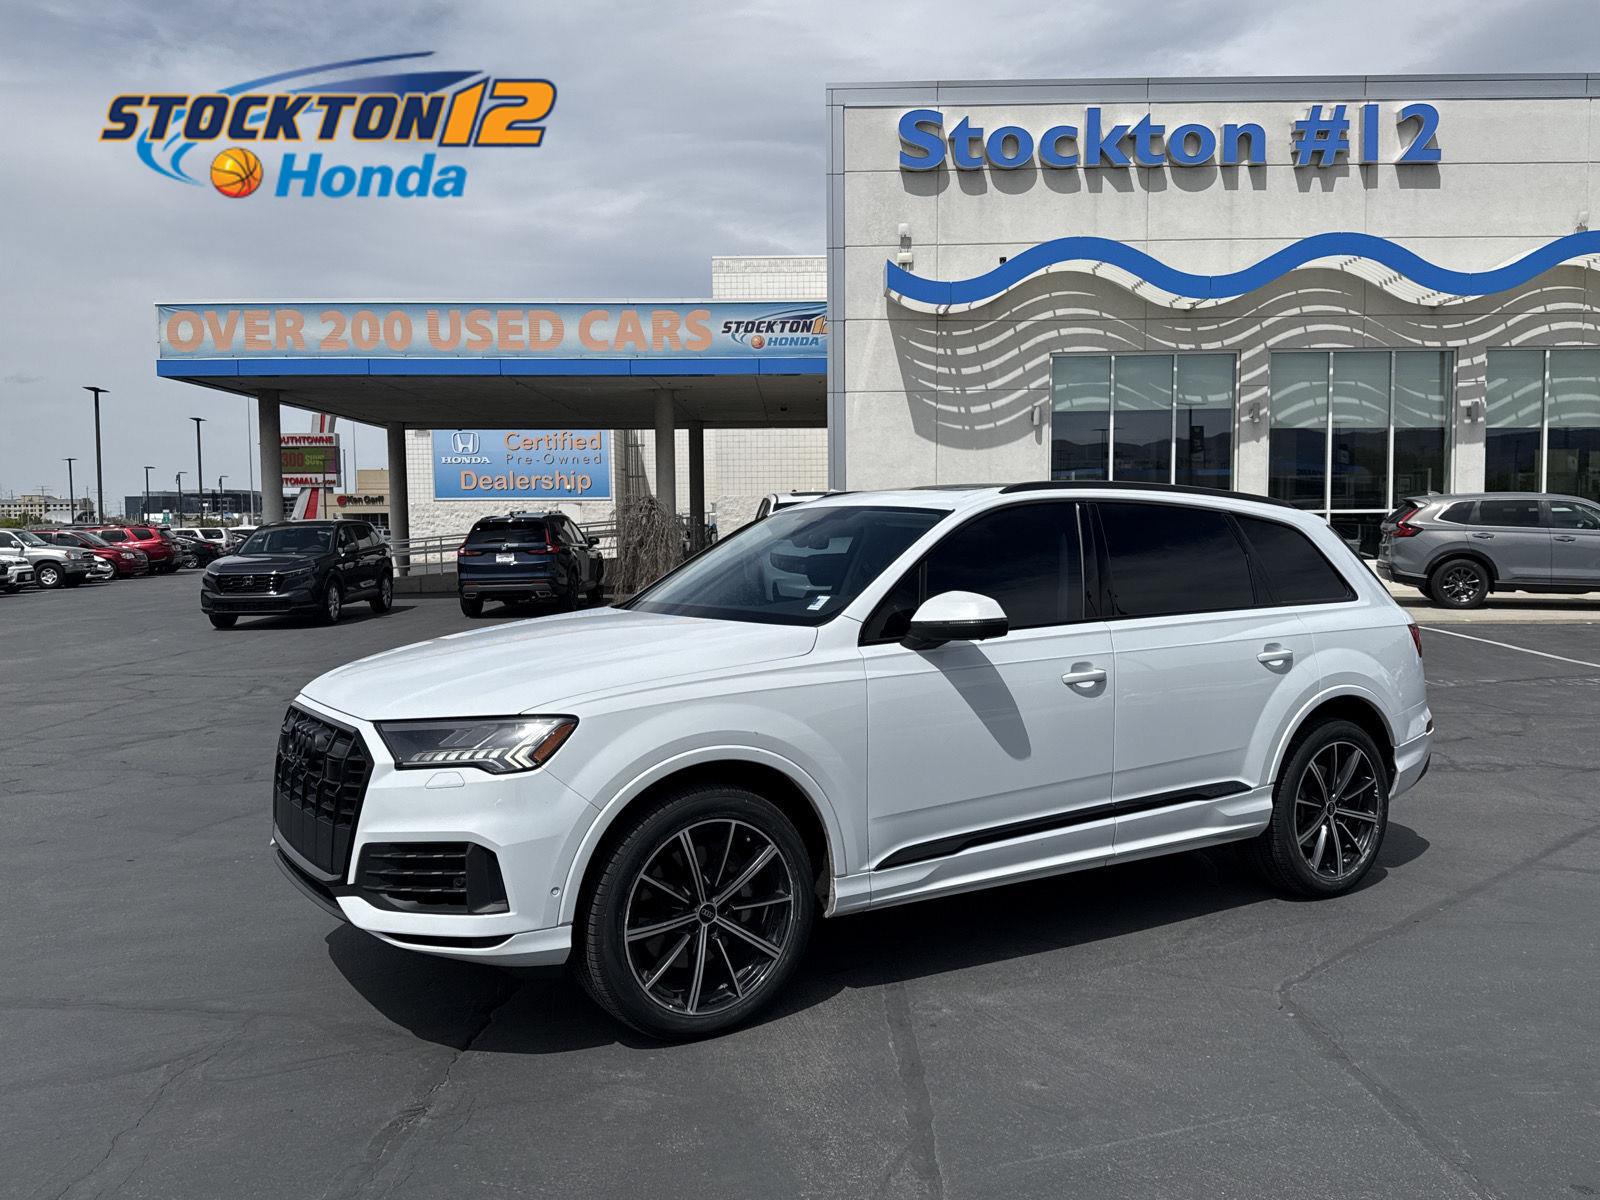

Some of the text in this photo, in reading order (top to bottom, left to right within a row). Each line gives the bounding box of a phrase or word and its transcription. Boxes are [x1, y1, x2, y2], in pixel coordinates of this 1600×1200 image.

[899, 102, 1441, 172] Stockton #12
[166, 308, 713, 352] OVER 200 USED CARS
[722, 320, 813, 334] STOCKTON
[767, 336, 819, 346] HONDA
[504, 431, 602, 451] Certified
[441, 456, 491, 465] HONDA
[506, 453, 602, 465] Pre-Owned
[460, 470, 593, 494] Dealership
